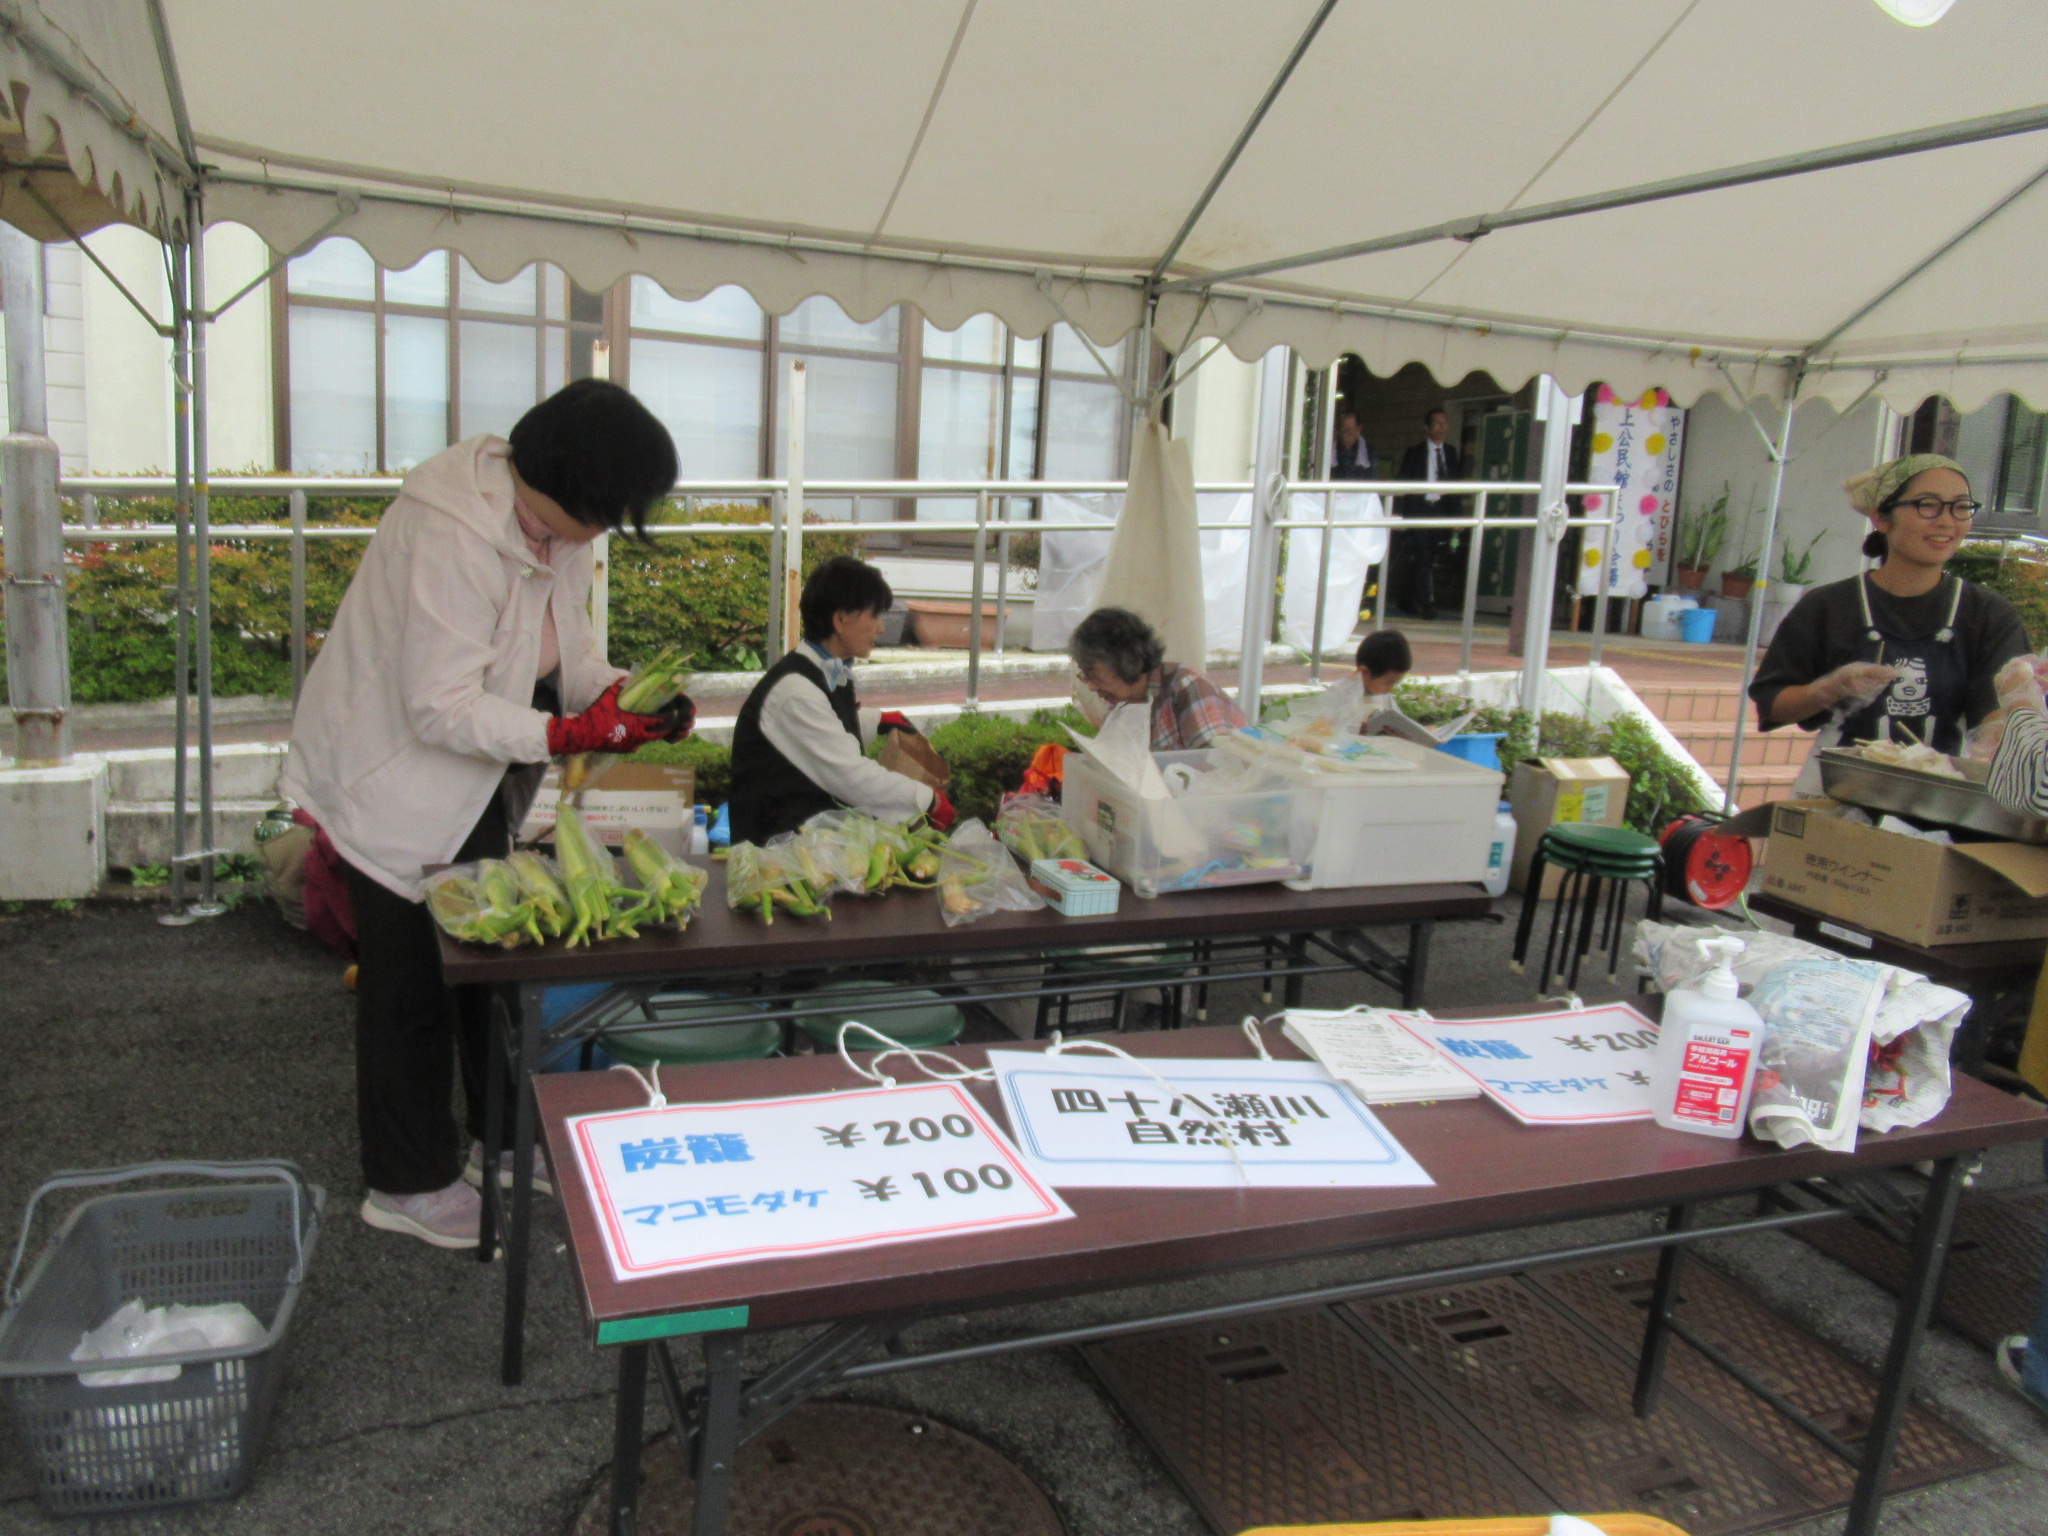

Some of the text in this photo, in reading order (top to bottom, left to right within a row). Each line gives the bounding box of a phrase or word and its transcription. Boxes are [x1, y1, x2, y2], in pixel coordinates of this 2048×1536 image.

[1689, 1053, 1738, 1068] アルコール
[1483, 1077, 1609, 1094] マコモダケ
[1050, 1087, 1331, 1120] 四十八瀬川
[814, 1113, 975, 1149] ¥200
[1125, 1117, 1292, 1147] 自然村
[622, 1163, 1014, 1226] マコモダケ ¥100
